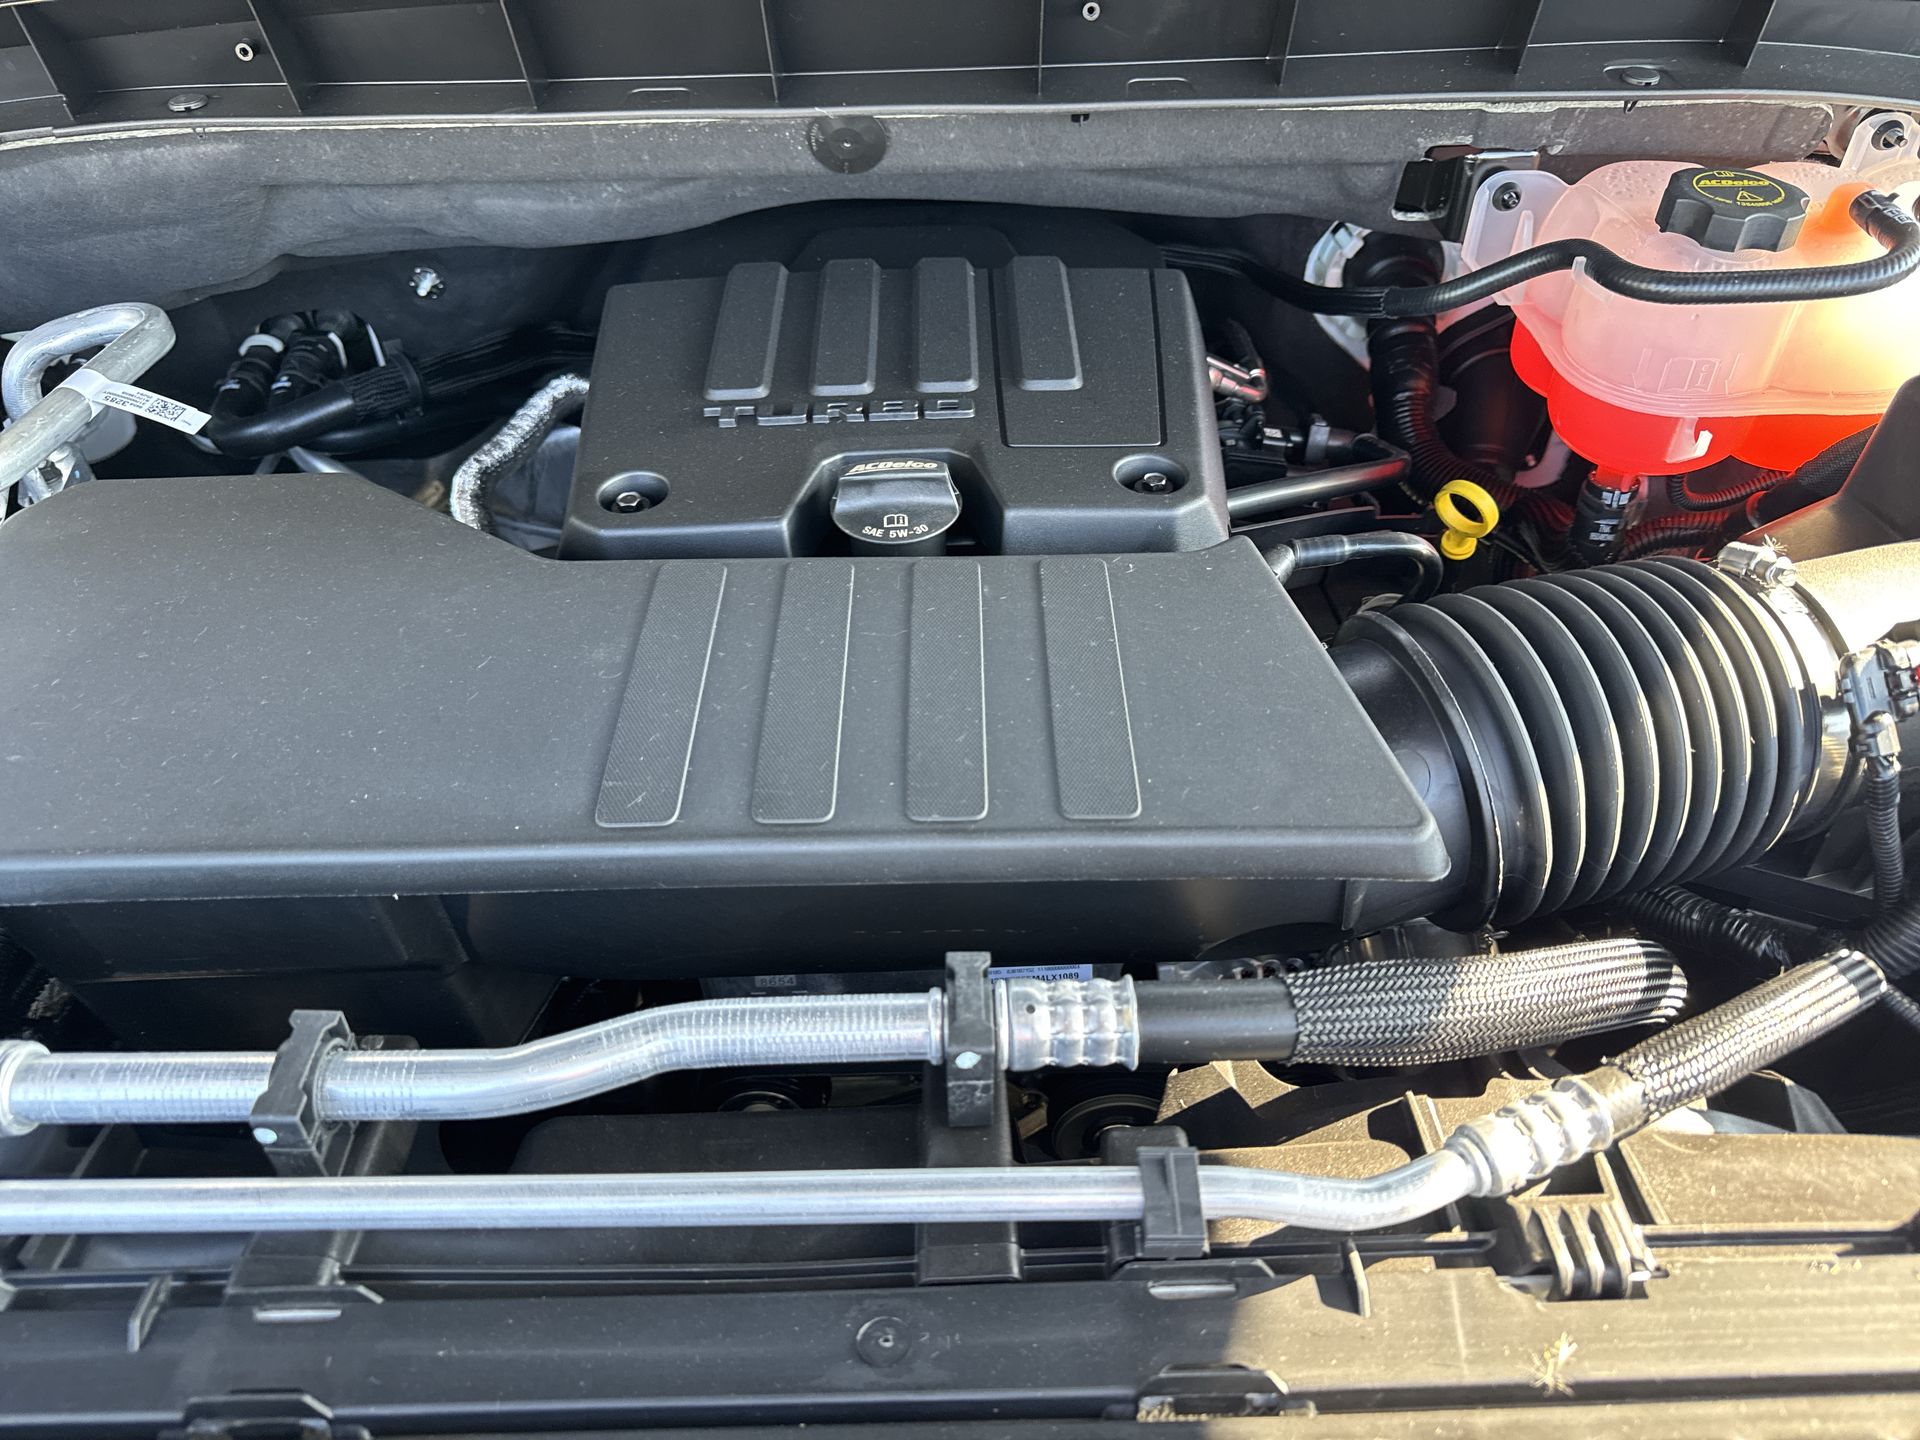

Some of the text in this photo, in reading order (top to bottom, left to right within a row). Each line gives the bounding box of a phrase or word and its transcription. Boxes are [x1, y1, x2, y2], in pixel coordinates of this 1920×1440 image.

[1698, 179, 1771, 188] ACDelco
[703, 399, 976, 428] TURBO
[847, 460, 938, 474] ACDelco
[862, 524, 928, 538] SAE 5W-30
